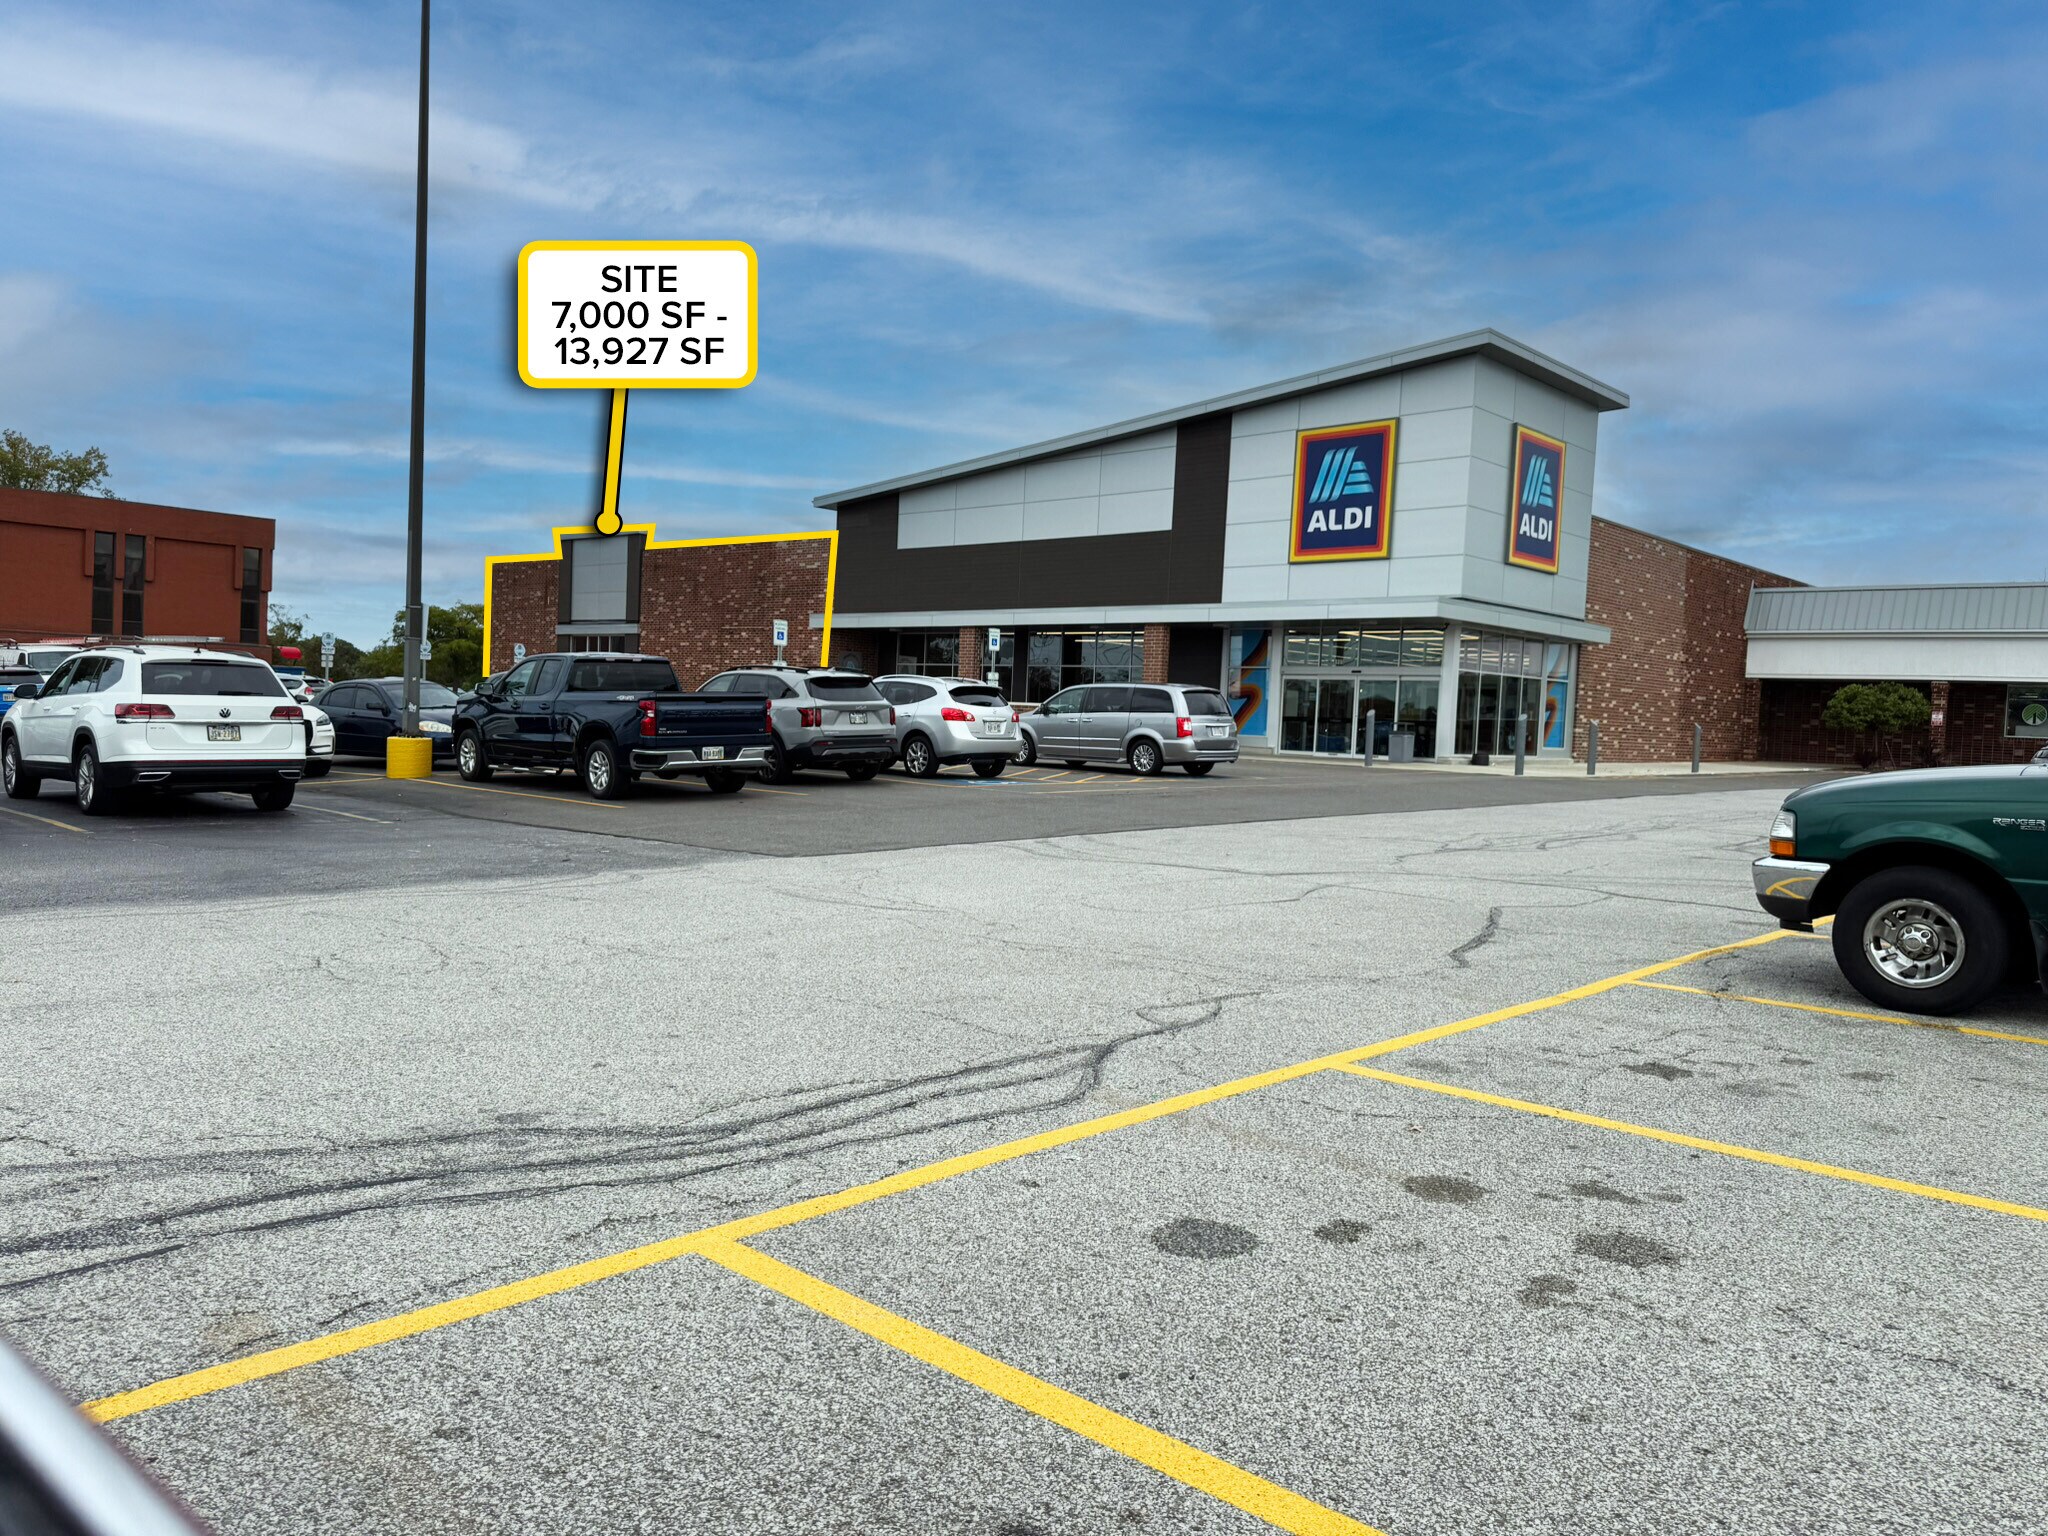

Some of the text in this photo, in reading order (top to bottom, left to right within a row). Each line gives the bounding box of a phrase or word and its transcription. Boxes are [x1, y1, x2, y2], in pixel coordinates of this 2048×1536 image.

[1307, 505, 1373, 533] ALDI
[1519, 513, 1553, 542] ALDI
[1992, 817, 2046, 827] RANGER
